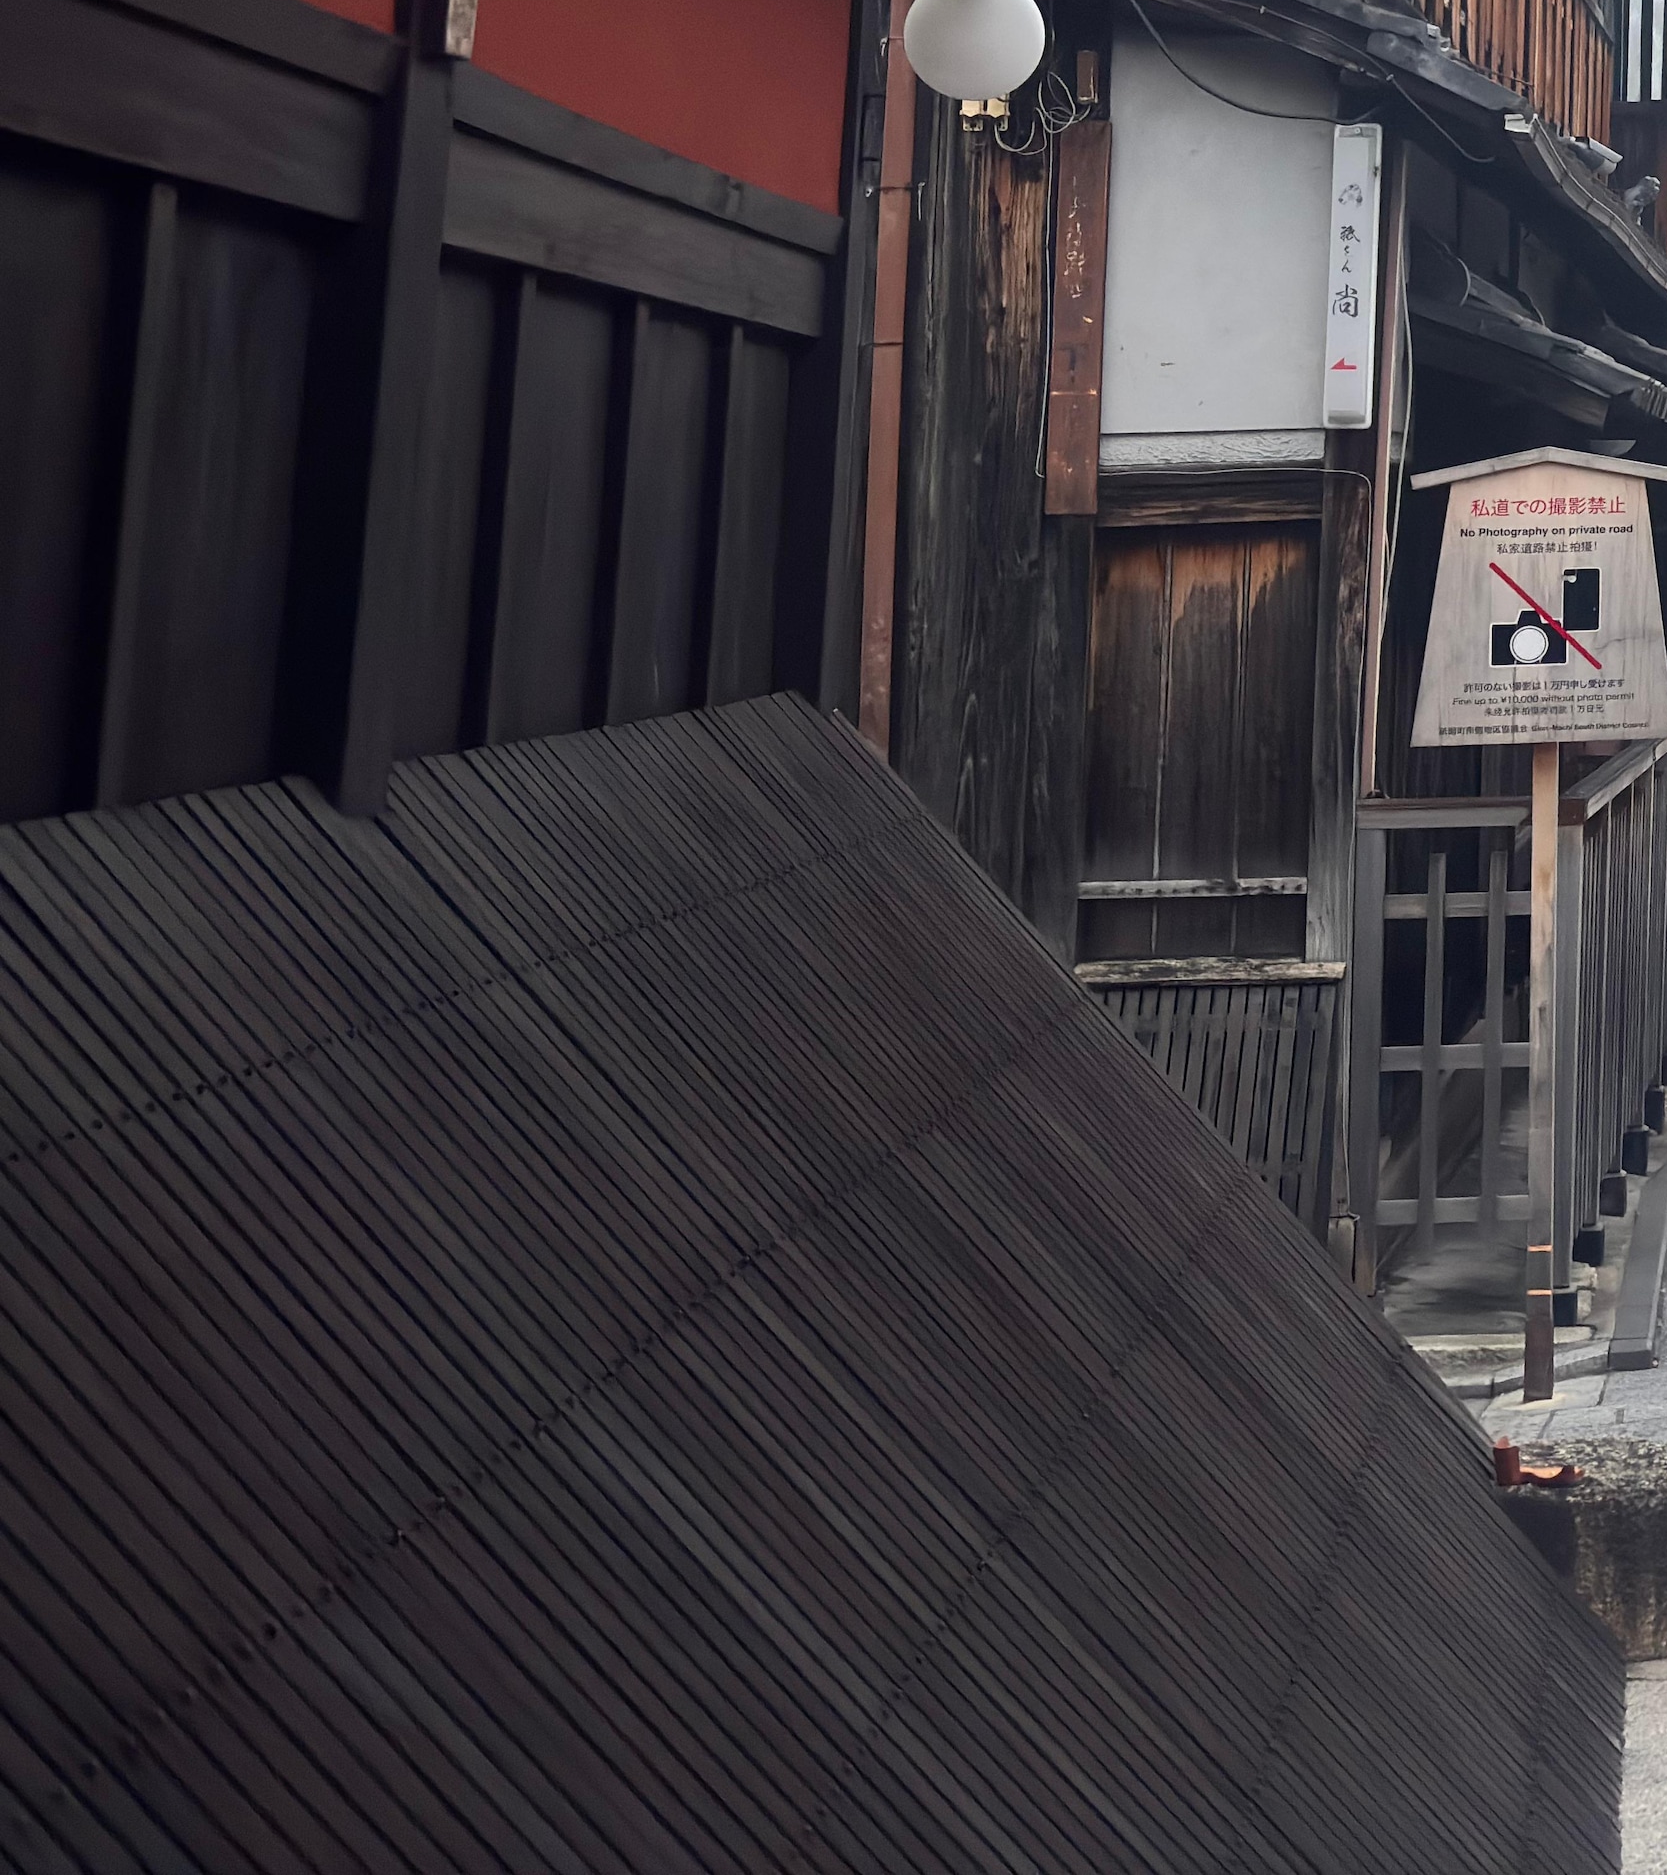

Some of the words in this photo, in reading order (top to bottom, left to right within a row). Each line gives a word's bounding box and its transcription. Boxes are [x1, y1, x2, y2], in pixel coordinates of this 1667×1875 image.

[1470, 496, 1626, 517] 私道での撮影禁止
[1460, 527, 1475, 538] No
[1479, 526, 1548, 538] Photography
[1552, 527, 1566, 536] on
[1569, 525, 1606, 537] private
[1609, 524, 1633, 534] road
[1474, 698, 1485, 707] up
[1488, 697, 1498, 705] to
[1541, 693, 1575, 703] without
[1577, 693, 1603, 703] photo
[1605, 692, 1635, 702] permit
